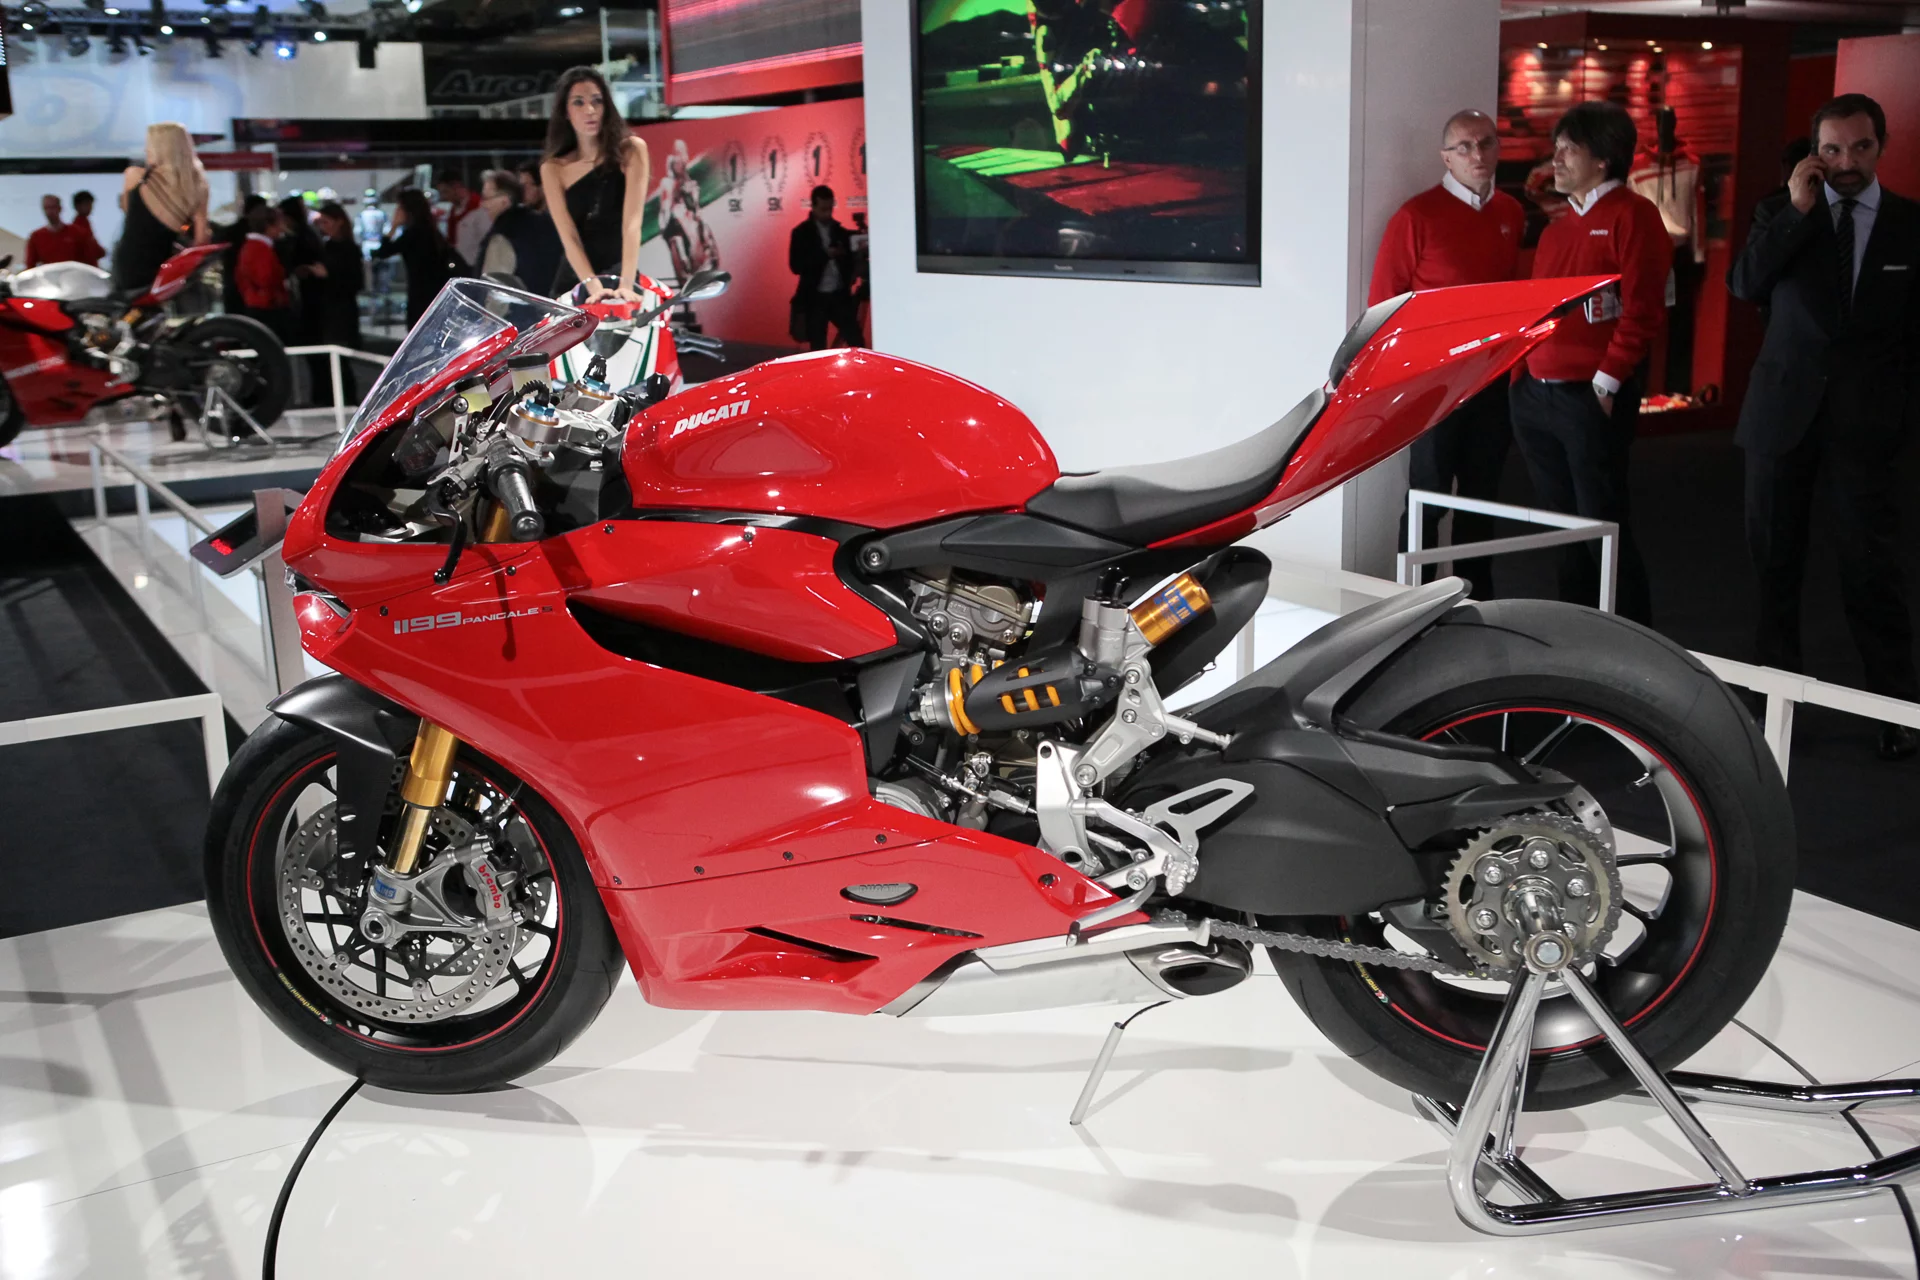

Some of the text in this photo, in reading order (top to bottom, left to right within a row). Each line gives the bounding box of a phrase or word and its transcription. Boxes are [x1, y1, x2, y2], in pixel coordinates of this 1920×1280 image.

[769, 150, 776, 179] 1
[813, 145, 821, 176] 1
[671, 399, 751, 437] DUCATI
[393, 611, 462, 635] 1199
[462, 607, 539, 625] PANIGALE
[478, 864, 502, 909] brembo
